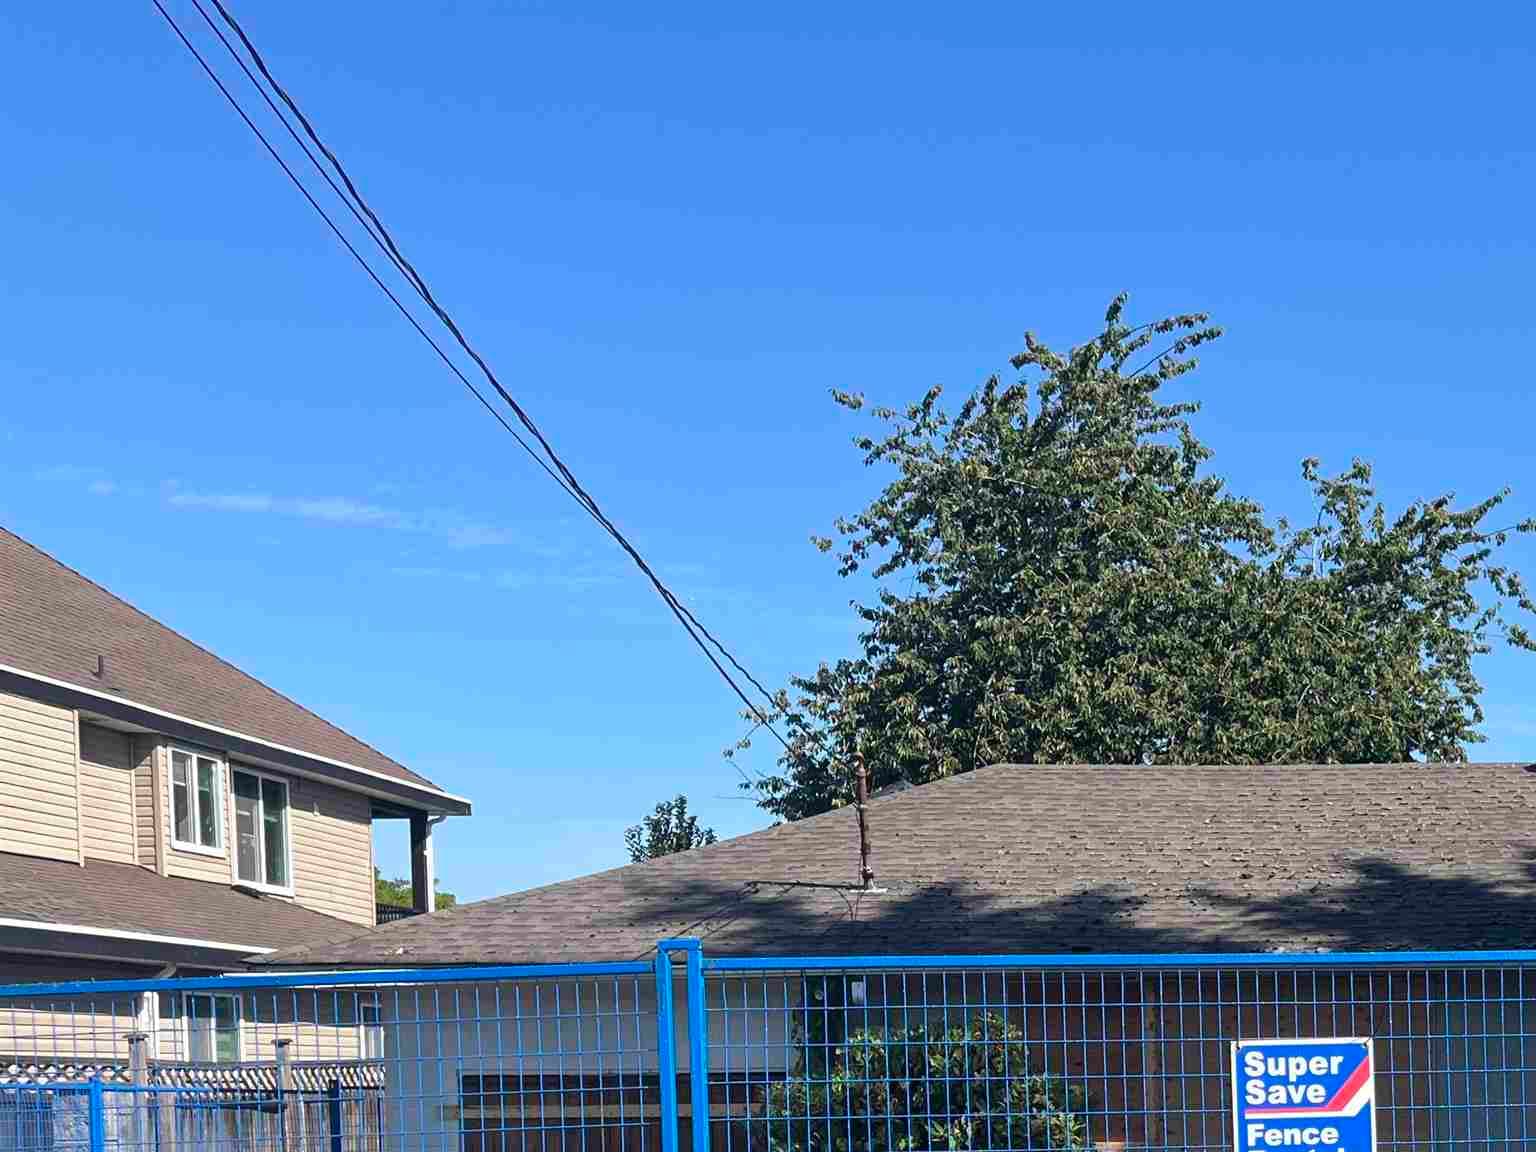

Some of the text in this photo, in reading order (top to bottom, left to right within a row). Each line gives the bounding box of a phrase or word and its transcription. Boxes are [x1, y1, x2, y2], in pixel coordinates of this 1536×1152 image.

[1243, 1050, 1344, 1082] Super
[1245, 1079, 1327, 1105] Save
[1247, 1123, 1340, 1147] Fence
